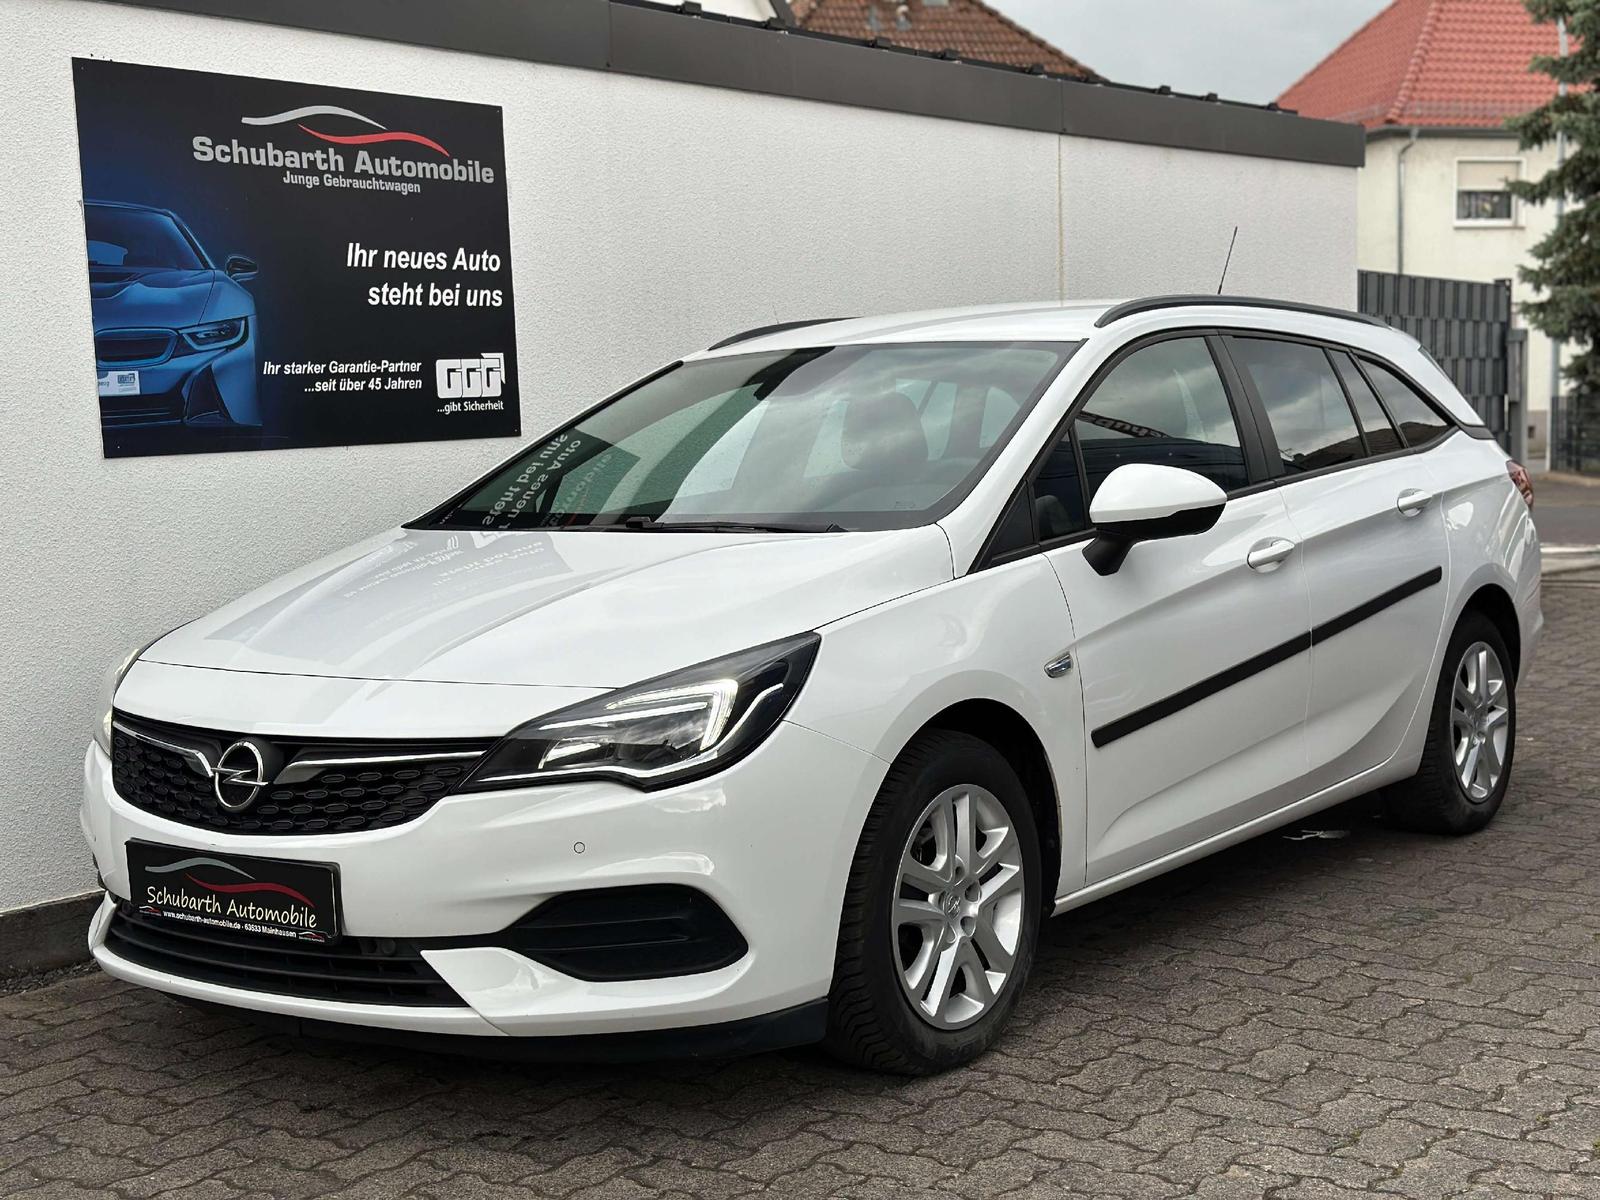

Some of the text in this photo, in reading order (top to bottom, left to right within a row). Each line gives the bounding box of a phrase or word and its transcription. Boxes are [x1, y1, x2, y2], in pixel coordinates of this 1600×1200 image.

[192, 135, 495, 184] Schubarth Automobile
[283, 170, 421, 196] Junge Gebrauchtwagen
[346, 242, 501, 272] Ihr neues Auto
[367, 282, 503, 307] steht bei uns
[263, 359, 422, 375] Ihr starker Garantie-Partner
[304, 377, 422, 392] ...seit über 45 Jahren
[463, 400, 504, 412] Sicherheit
[147, 886, 317, 928] Schubarth Automobile
